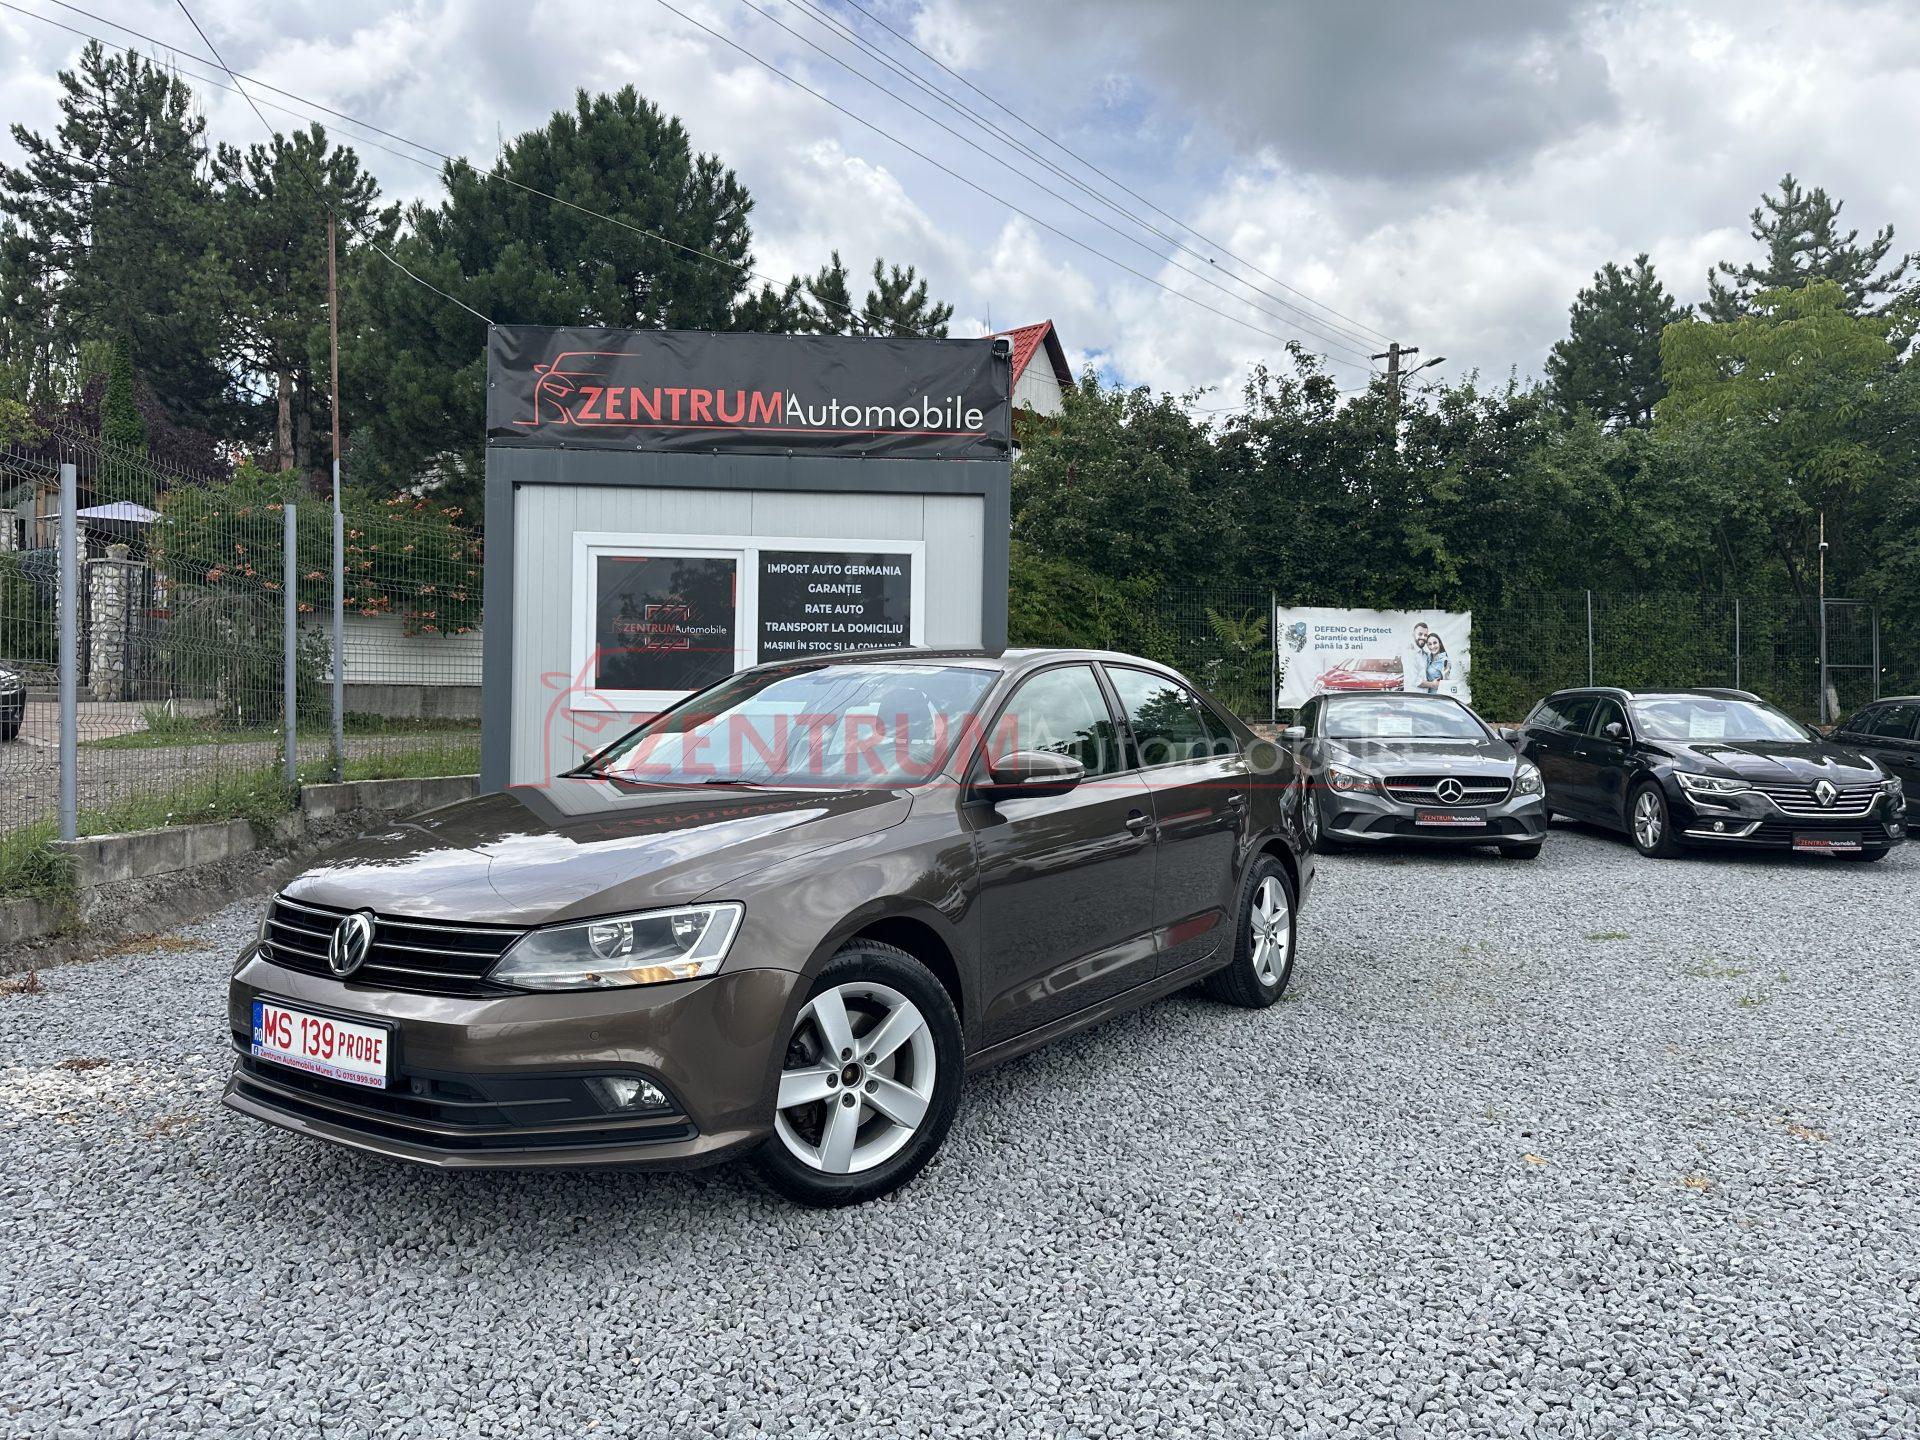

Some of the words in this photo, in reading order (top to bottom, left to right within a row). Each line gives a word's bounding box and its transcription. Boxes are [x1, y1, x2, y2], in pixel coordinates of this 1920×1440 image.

[577, 386, 782, 424] ZENTRUM
[786, 394, 984, 431] Automobile
[767, 564, 810, 574] IMPORT
[811, 565, 842, 575] AUTO
[844, 566, 902, 576] GERMANIA
[804, 604, 832, 614] RATE
[834, 605, 864, 615] AUTO
[623, 623, 676, 633] ZENTRUM
[675, 624, 727, 635] Automobile
[765, 622, 830, 633] TRANSPORT
[831, 624, 846, 633] LA
[847, 624, 904, 634] DOMICILIU
[1348, 626, 1362, 634] Car
[808, 641, 832, 651] STOC
[844, 642, 856, 651] LA
[1335, 642, 1343, 650] la
[1351, 642, 1363, 650] ani
[264, 1008, 292, 1049] MS
[301, 1017, 335, 1060] 139
[338, 1031, 383, 1065] PROBE
[260, 1049, 283, 1062] Zentrum
[283, 1056, 315, 1071] Automobile
